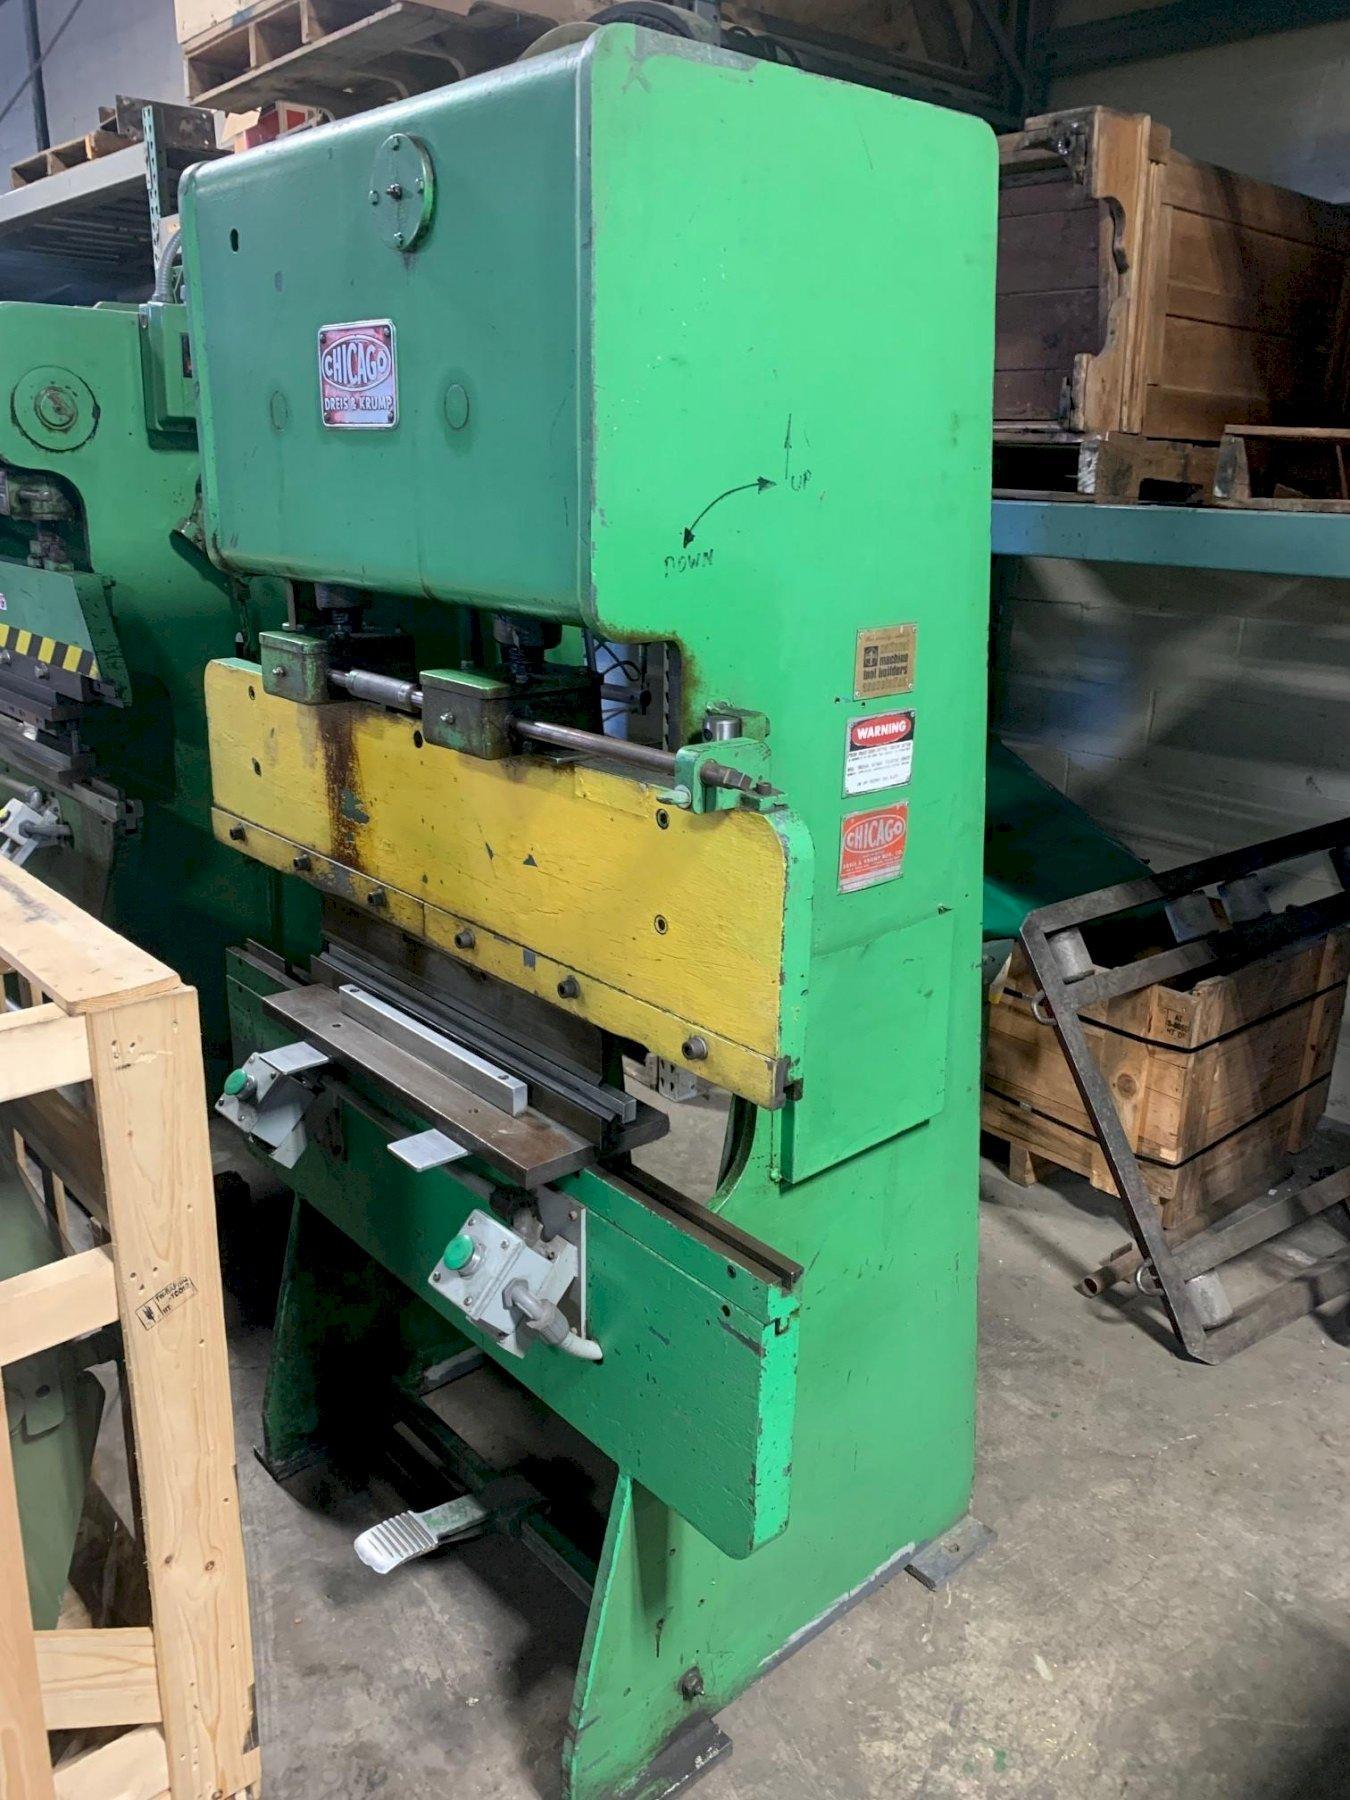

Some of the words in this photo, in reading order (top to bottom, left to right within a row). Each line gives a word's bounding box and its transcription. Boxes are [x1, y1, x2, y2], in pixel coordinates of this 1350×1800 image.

[324, 342, 387, 384] CHICAGO
[324, 397, 348, 410] DREIS
[360, 396, 392, 410] KRUMP
[791, 469, 811, 491] UP
[857, 720, 907, 740] WARNING
[846, 819, 903, 849] CHICAGO
